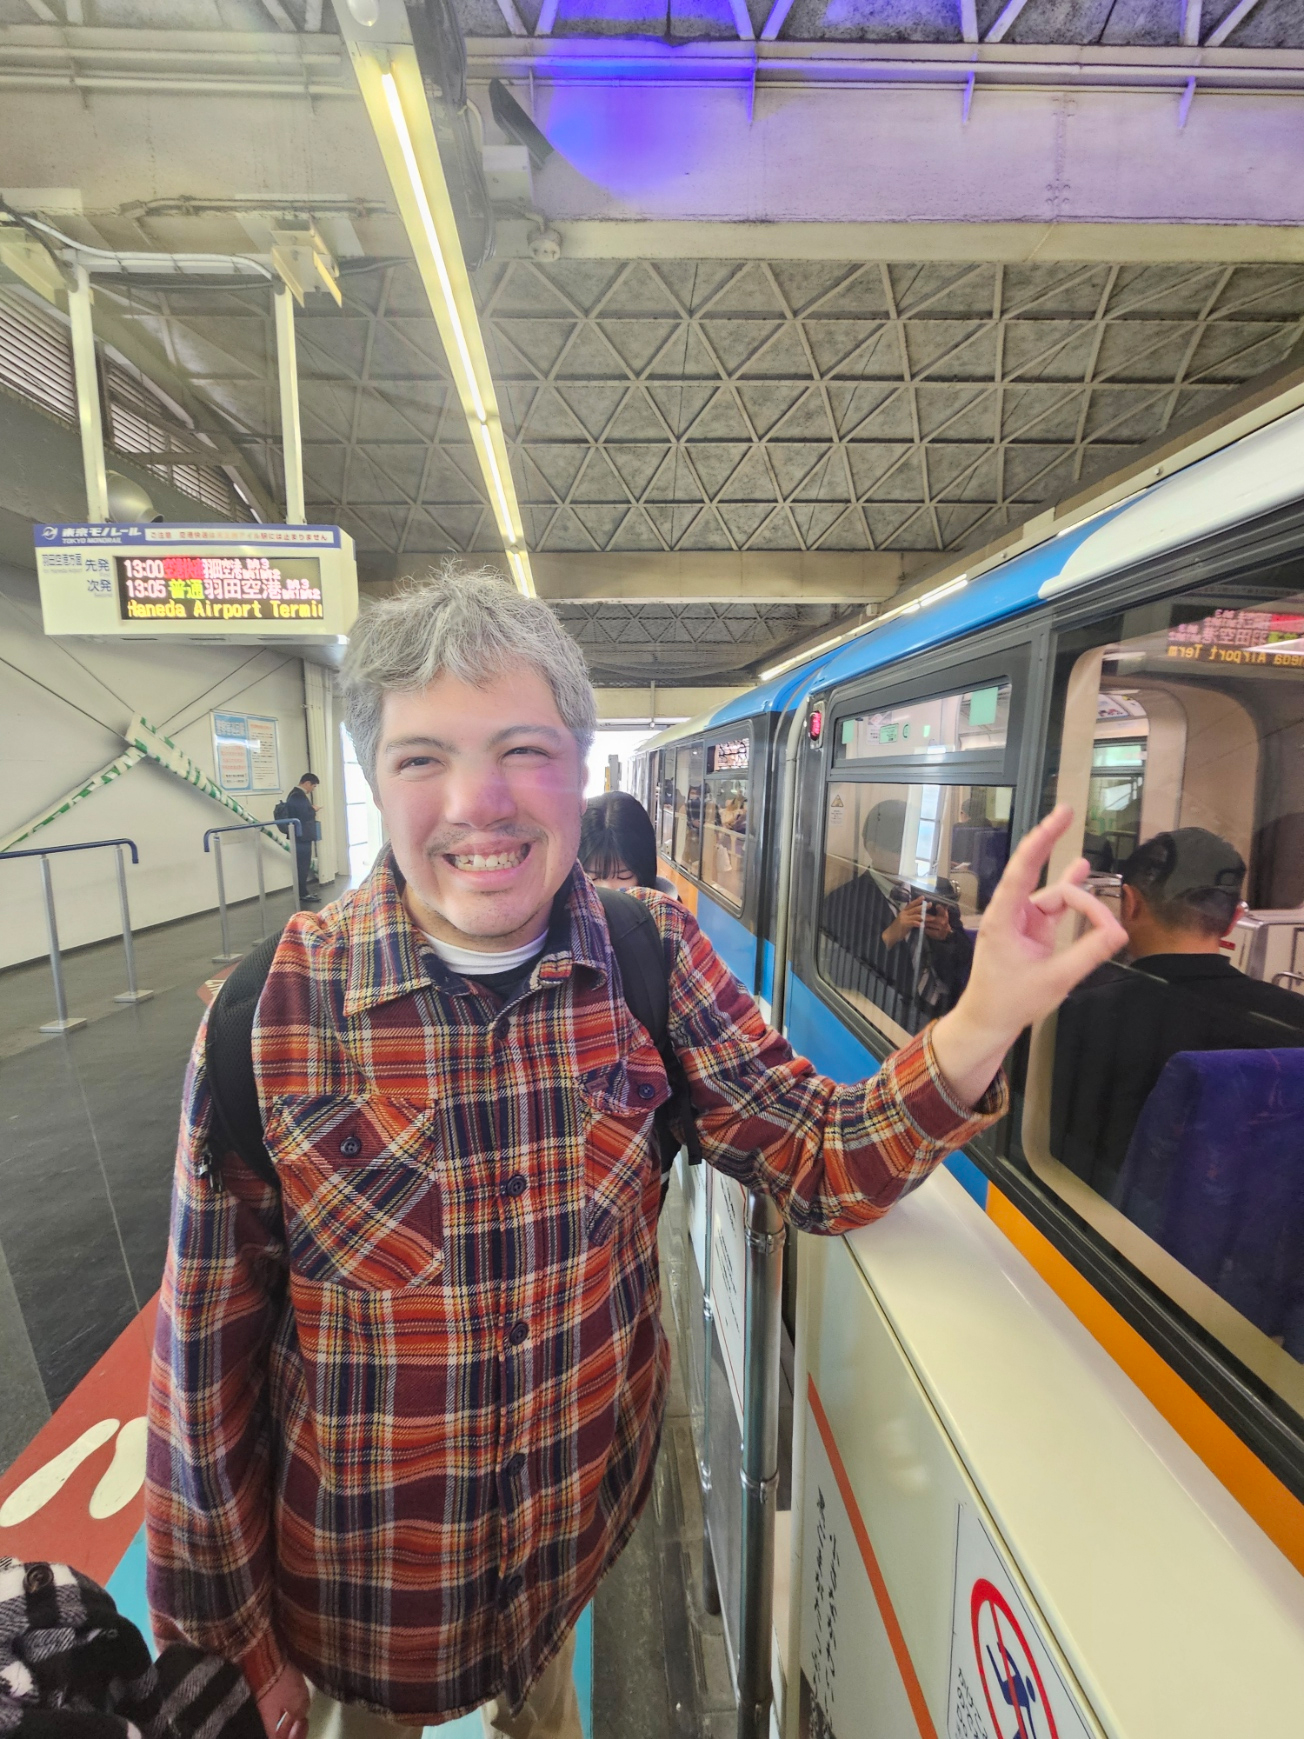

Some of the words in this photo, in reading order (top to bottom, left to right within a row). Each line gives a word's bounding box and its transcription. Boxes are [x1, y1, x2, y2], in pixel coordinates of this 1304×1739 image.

[62, 527, 142, 537] 東京モノレール
[85, 558, 110, 572] 先発
[124, 559, 164, 578] 13:00
[203, 558, 242, 579] 羽田空港
[87, 579, 112, 592] 次発
[126, 579, 166, 598] 13:05
[168, 579, 205, 599] 普通
[204, 579, 281, 599] 羽田空港
[128, 599, 186, 618] Haneda
[193, 599, 262, 620] Airport
